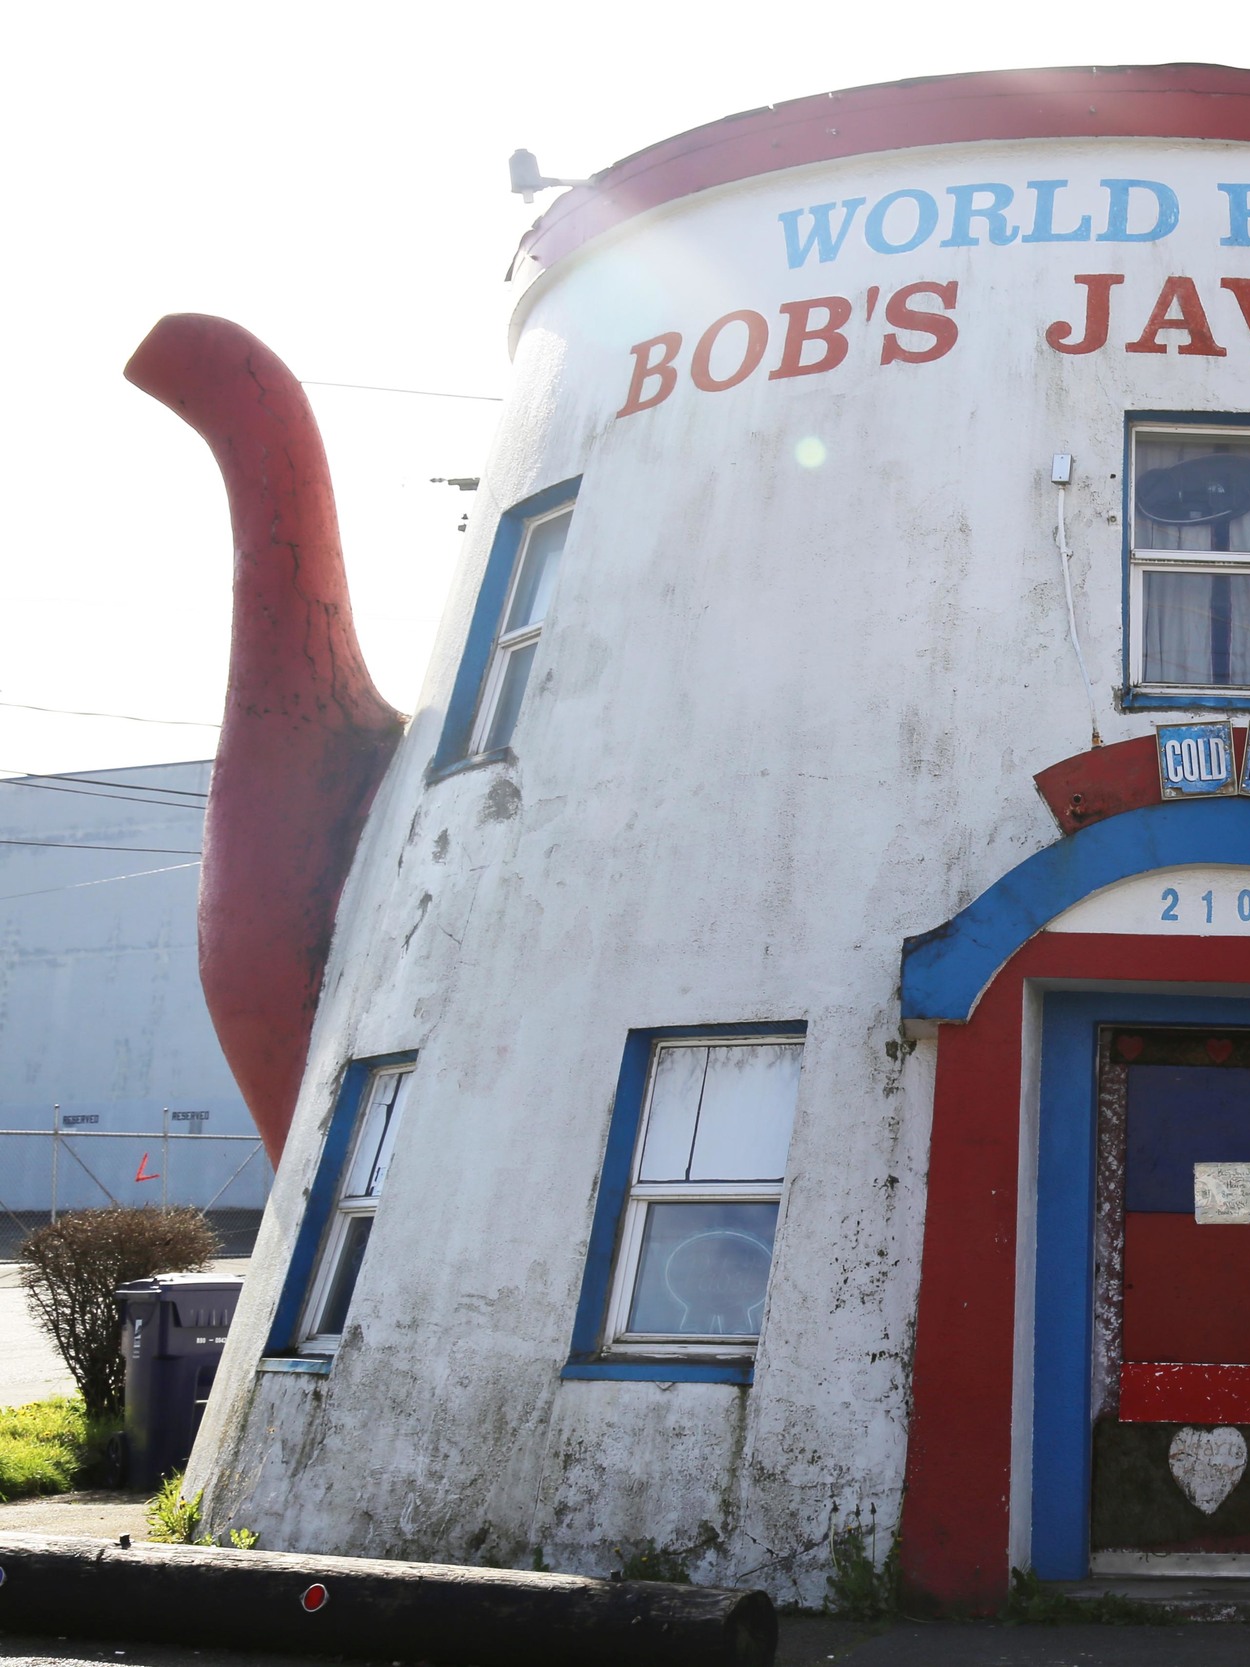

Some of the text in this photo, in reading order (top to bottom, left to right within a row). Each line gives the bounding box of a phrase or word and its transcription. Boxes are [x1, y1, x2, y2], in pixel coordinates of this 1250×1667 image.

[777, 179, 1180, 269] WORLD
[616, 280, 959, 419] BOB'S
[1165, 738, 1227, 783] COLD
[63, 1114, 100, 1125] RESERVED
[172, 1110, 210, 1121] RESERVED
